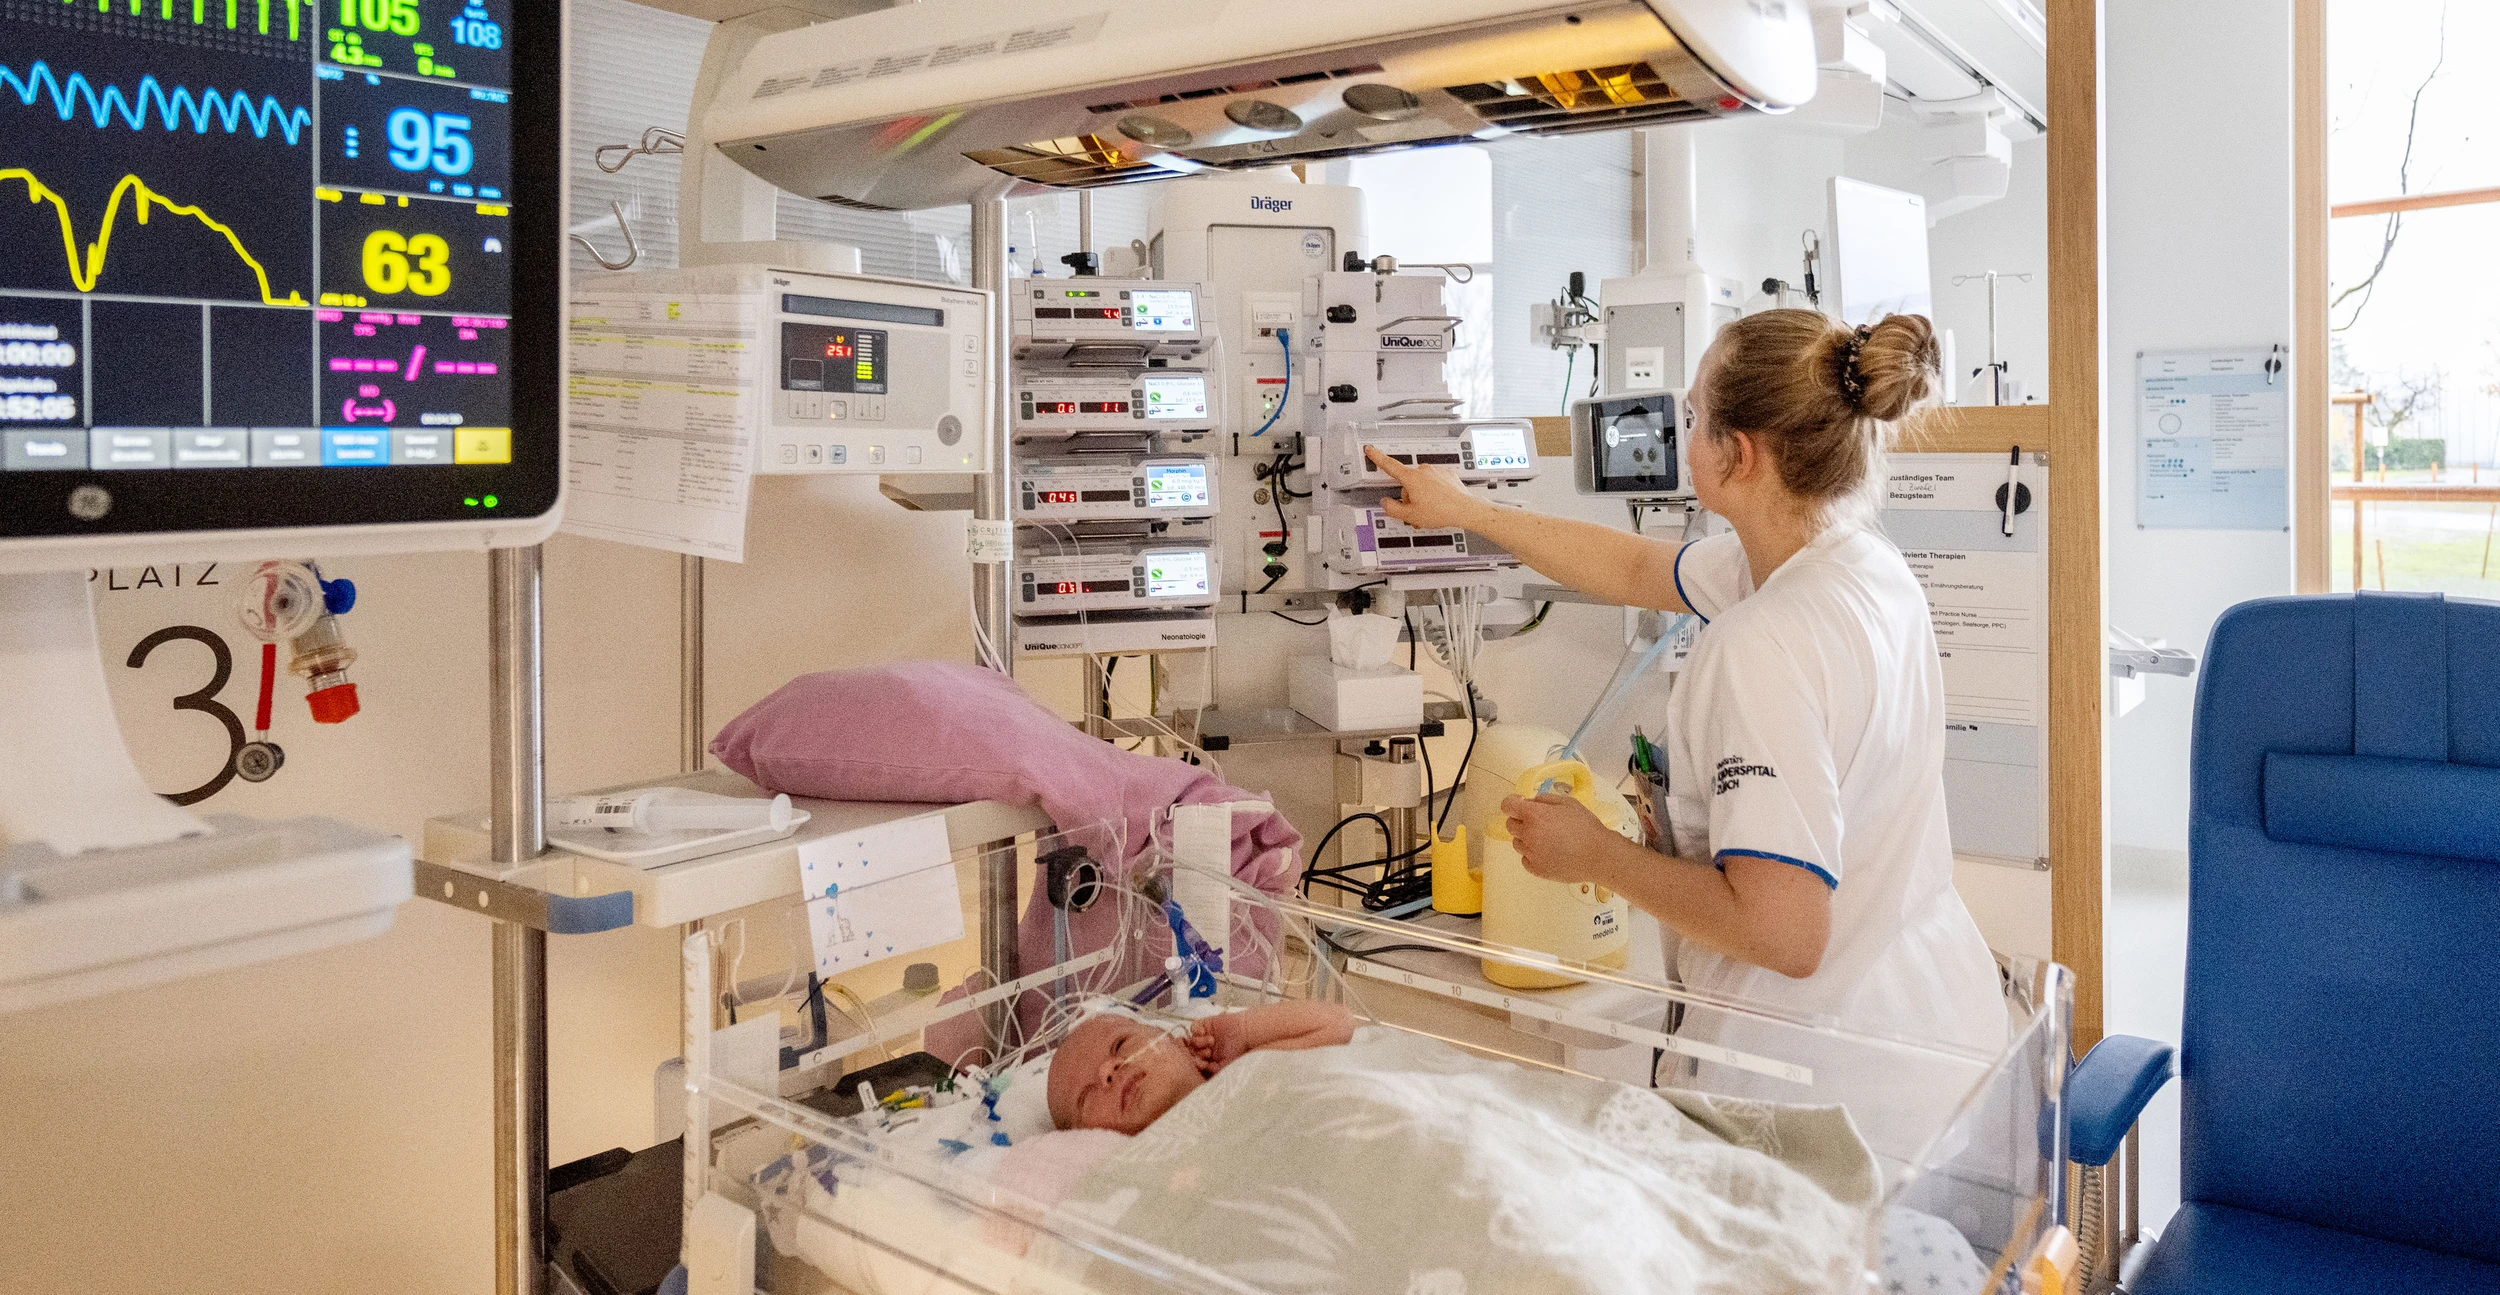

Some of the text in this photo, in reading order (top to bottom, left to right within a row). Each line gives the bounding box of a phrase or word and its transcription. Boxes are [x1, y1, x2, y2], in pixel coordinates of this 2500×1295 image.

[339, 0, 420, 36] 105
[451, 16, 503, 50] 108
[386, 106, 474, 176] 95
[1251, 196, 1293, 213] Dräger
[362, 229, 451, 297] 63
[1890, 475, 1933, 483] zuständiges
[1890, 492, 1934, 500] Bezugsteam
[1930, 552, 1966, 560] Therapien
[1930, 582, 1984, 590] Ernährungsberatung
[1161, 633, 1206, 641] Neonatologie
[126, 625, 247, 807] 3
[1014, 981, 1022, 992] A
[1355, 961, 1368, 973] 20
[1451, 986, 1462, 997] 10
[1503, 998, 1510, 1009] 5
[1665, 1037, 1678, 1049] 10
